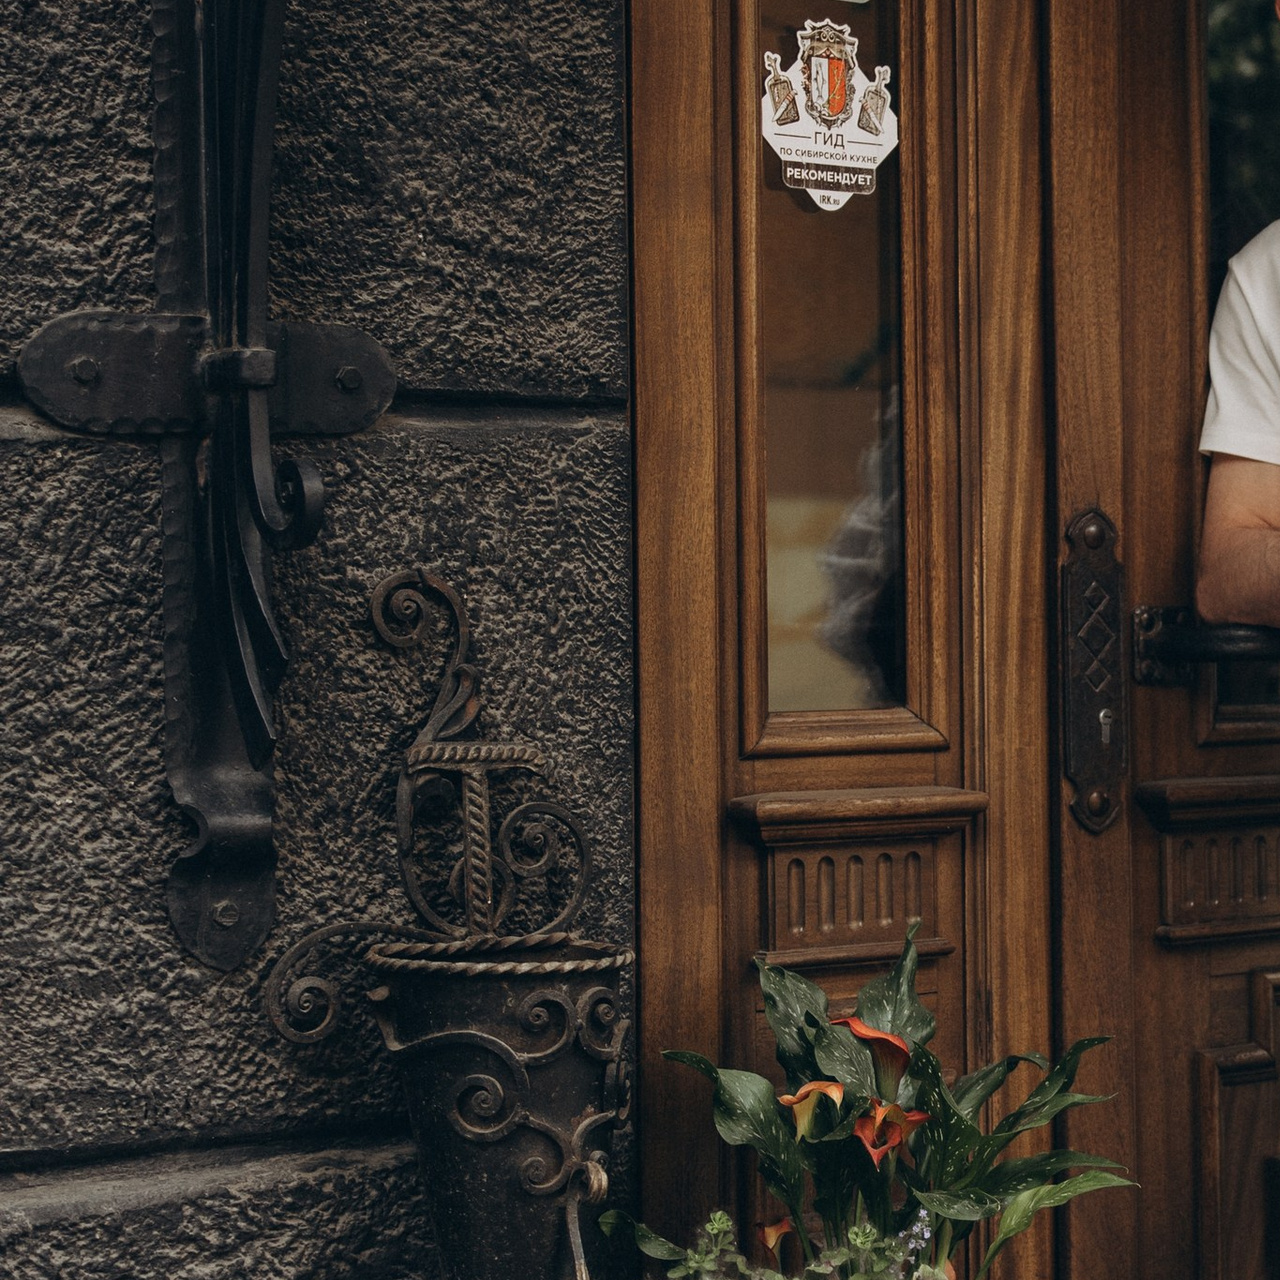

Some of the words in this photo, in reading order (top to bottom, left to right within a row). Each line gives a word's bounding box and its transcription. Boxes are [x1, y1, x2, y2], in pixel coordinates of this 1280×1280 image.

[814, 131, 845, 150] ГИД
[779, 147, 793, 156] ПО
[794, 148, 848, 161] СИБИРСКОЙ
[849, 155, 878, 164] КУХНЕ
[786, 167, 872, 186] РЕКОМЕНДУЕТ
